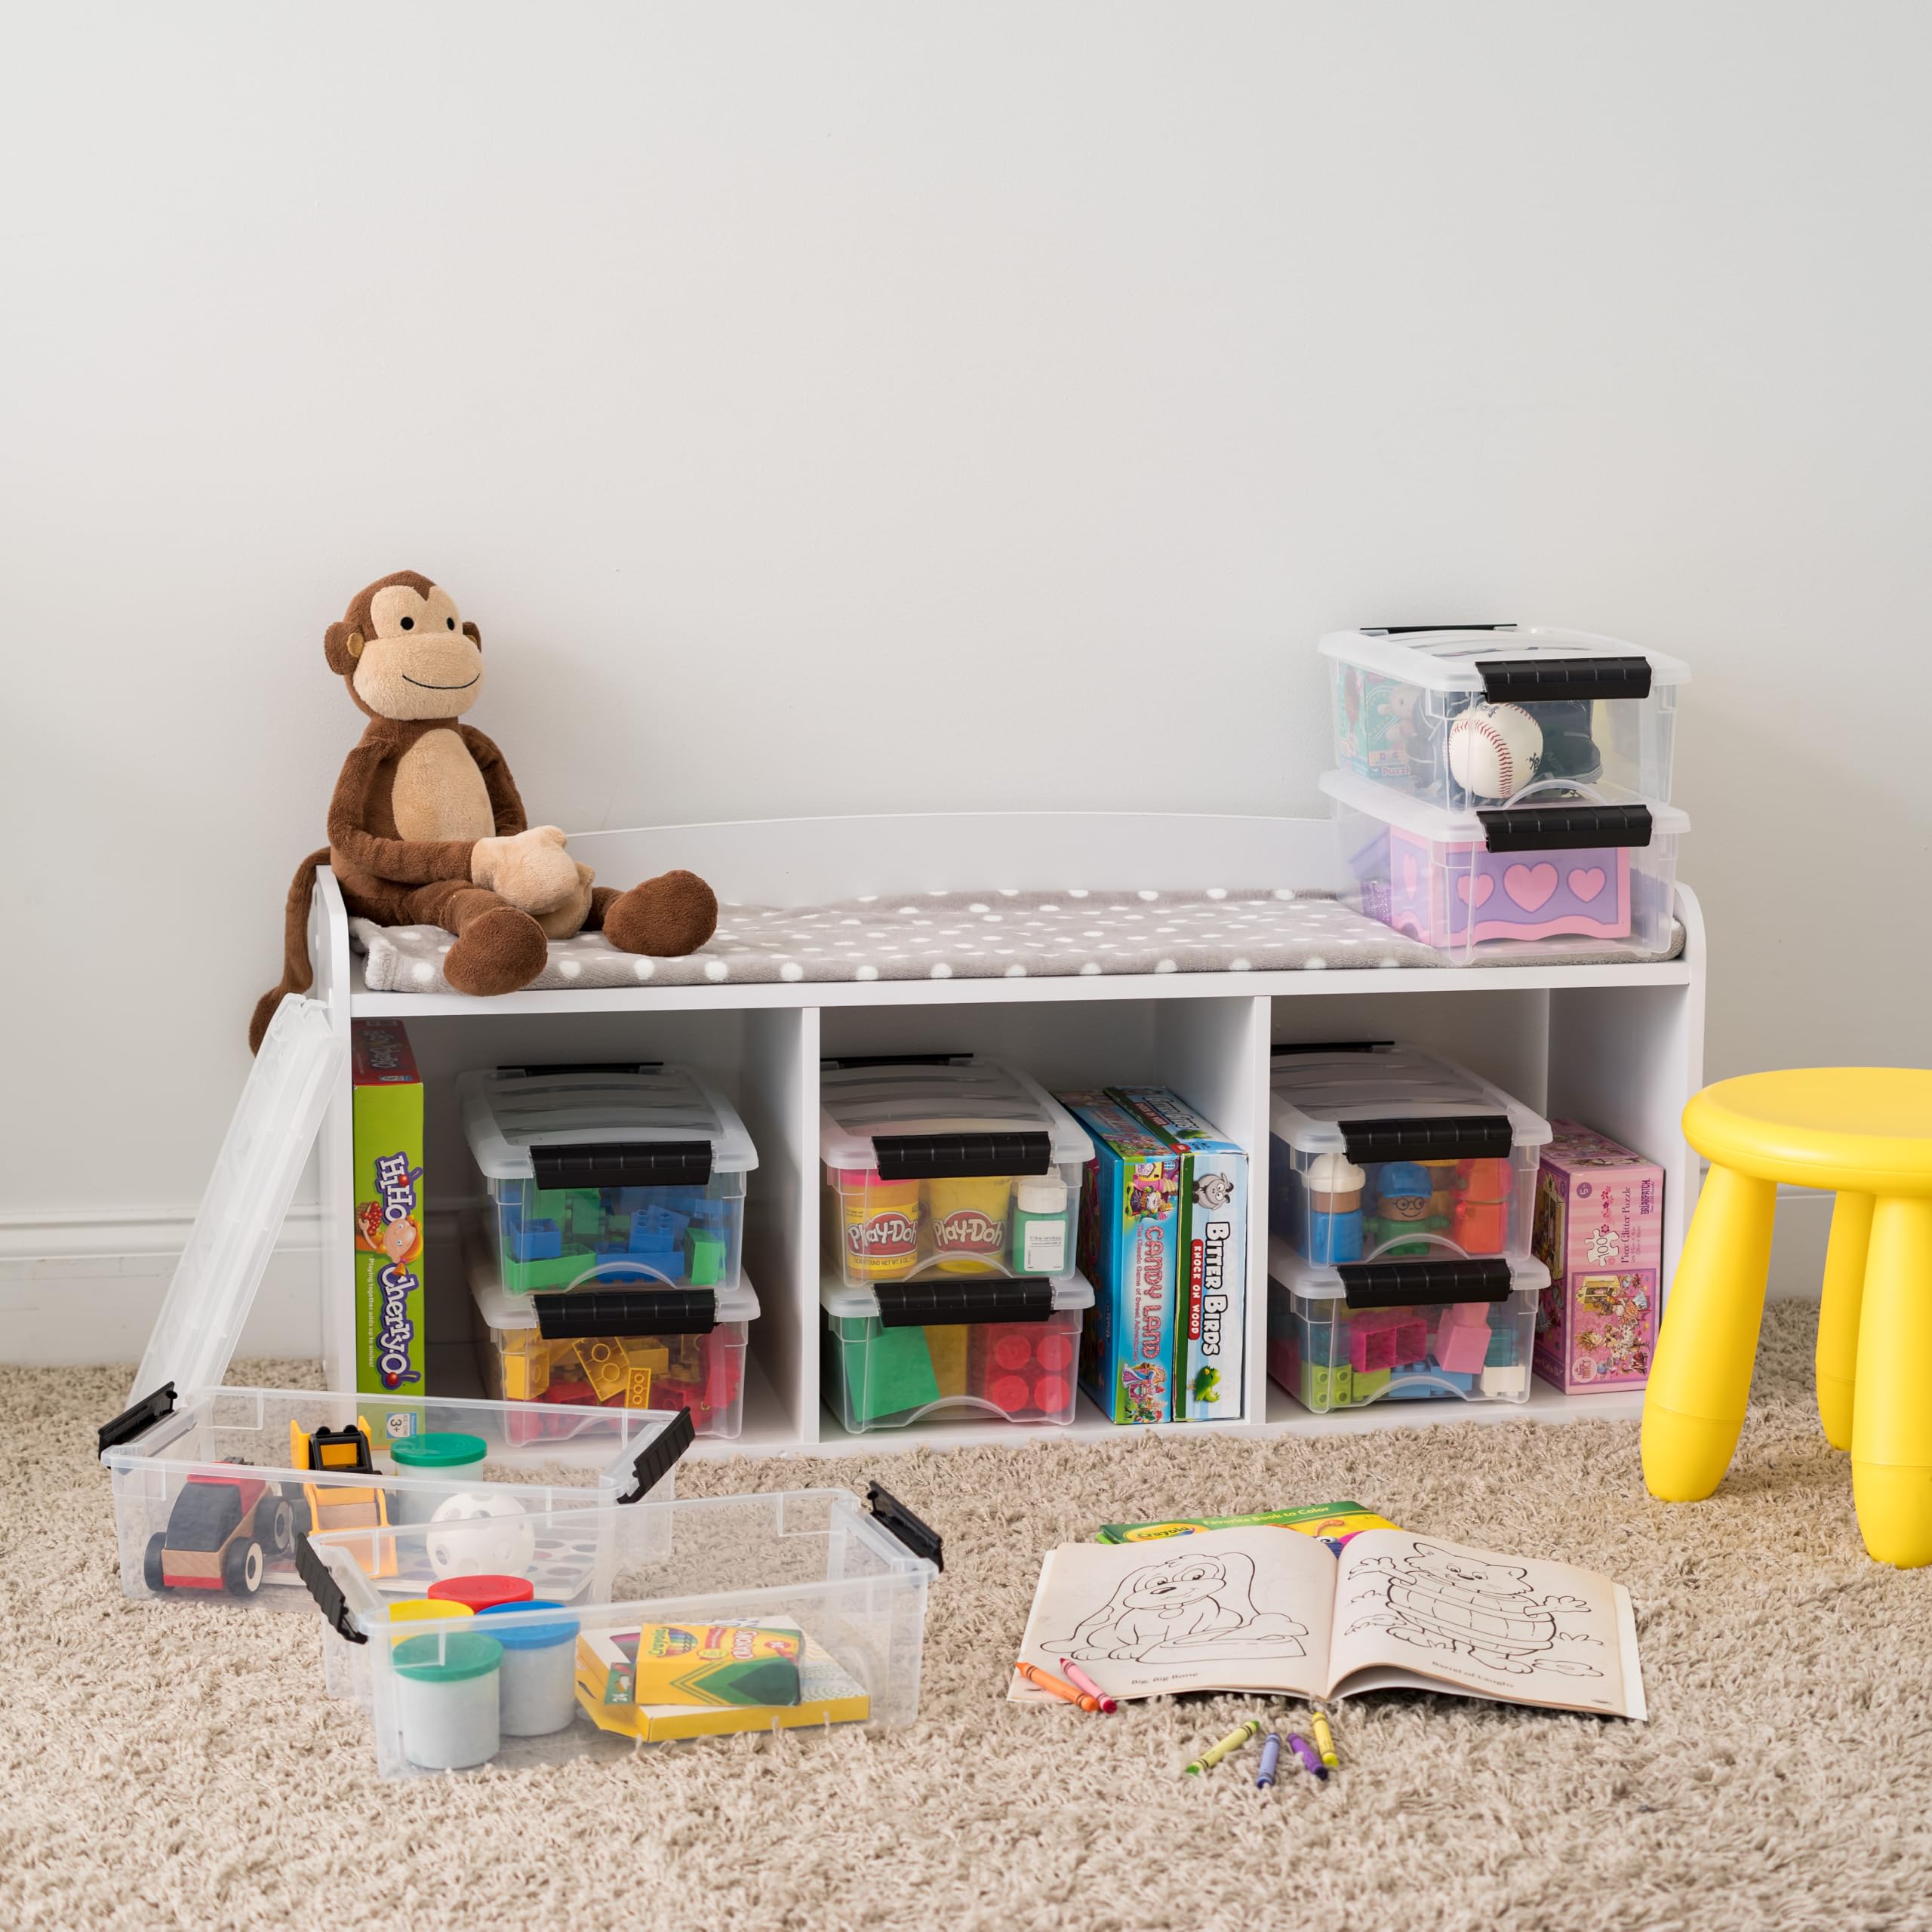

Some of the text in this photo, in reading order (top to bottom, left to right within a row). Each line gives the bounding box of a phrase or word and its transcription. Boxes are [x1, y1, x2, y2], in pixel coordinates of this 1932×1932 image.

[847, 1219, 918, 1251] Play-Doh
[932, 1218, 1004, 1248] Play-Doh
[1620, 1186, 1631, 1263] Piece Glitter Puzzle
[1595, 1237, 1610, 1257] 100
[1135, 1287, 1141, 1296] of
[1141, 1225, 1164, 1359] CANDY LAND
[1190, 1245, 1202, 1334] KNOCK ON WOOD
[1201, 1221, 1231, 1356] BITTER BIRDS
[367, 1327, 374, 1337] up
[390, 1418, 402, 1432] 3+
[1298, 1506, 1329, 1515] Color
[1136, 1526, 1189, 1538] Crayola
[647, 1628, 667, 1656] Crayola
[733, 1630, 758, 1660] CRAYONS
